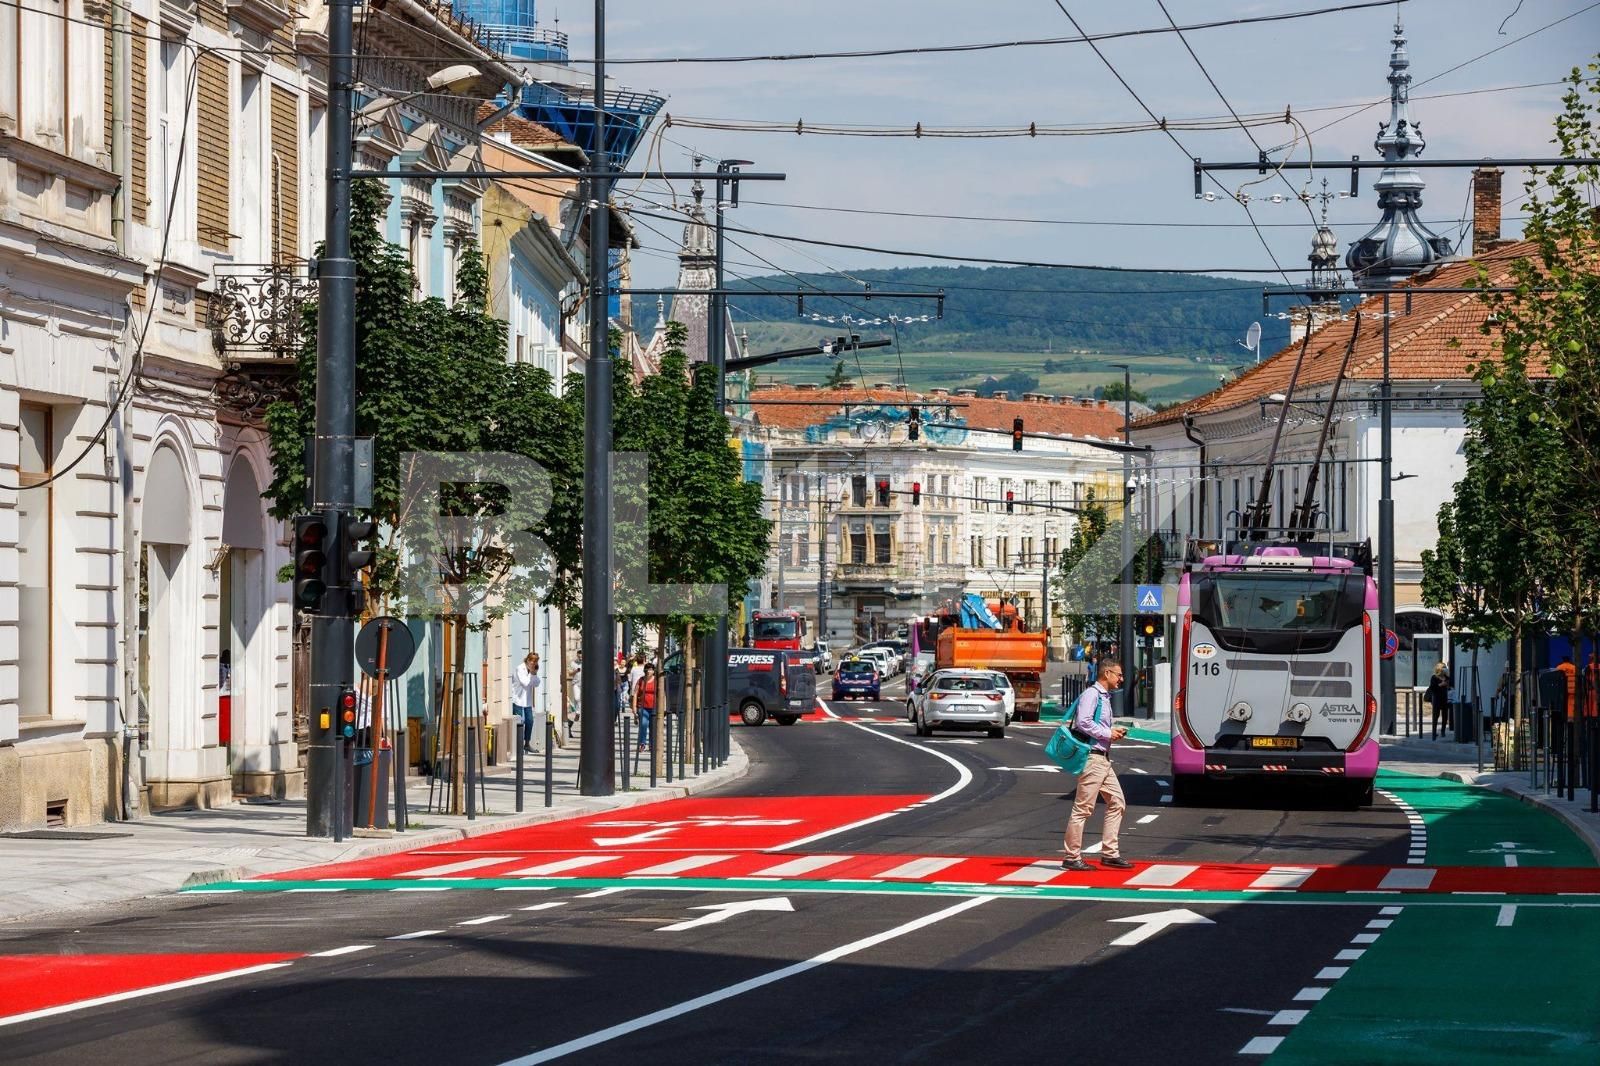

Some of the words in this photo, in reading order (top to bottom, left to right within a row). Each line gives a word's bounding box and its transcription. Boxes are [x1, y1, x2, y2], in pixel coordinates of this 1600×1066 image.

[729, 655, 775, 664] EXPRESS
[1192, 662, 1220, 676] 116
[1319, 702, 1361, 717] ASTRA
